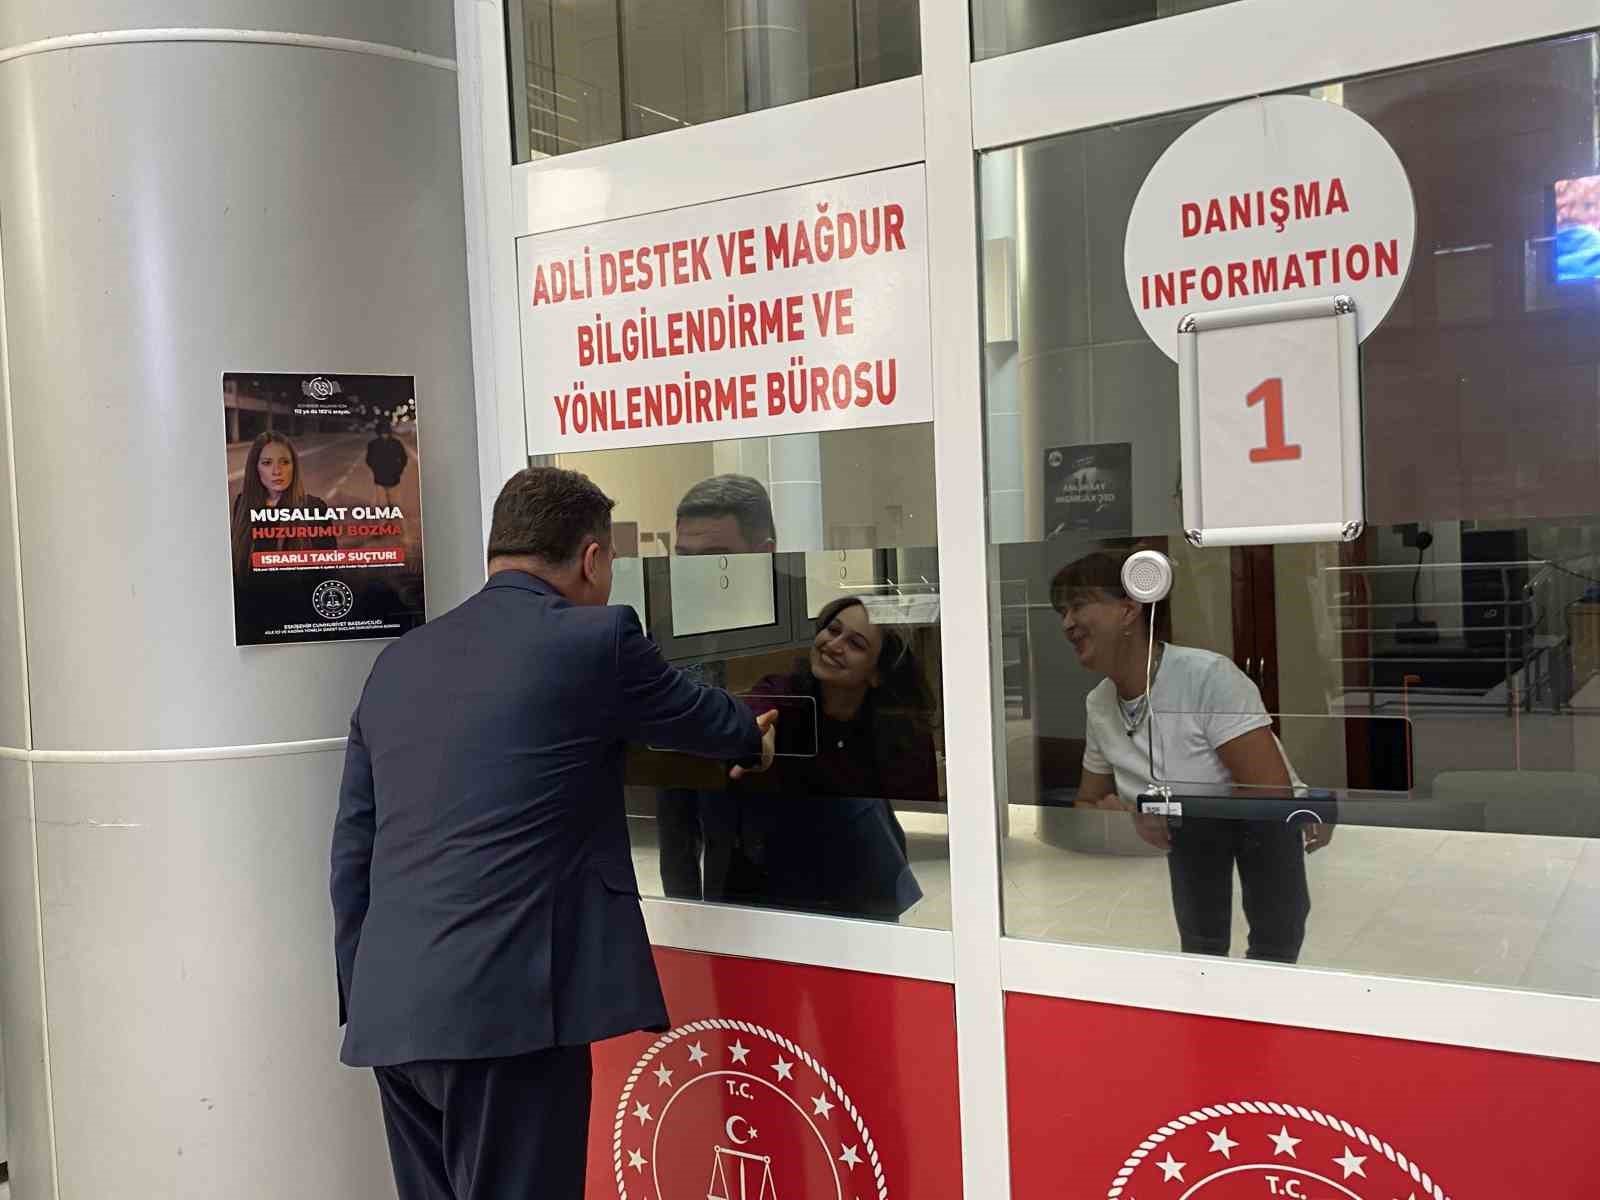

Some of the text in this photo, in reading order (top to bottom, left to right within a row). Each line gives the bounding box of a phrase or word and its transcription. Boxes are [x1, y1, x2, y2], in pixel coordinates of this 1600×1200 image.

[1181, 178, 1349, 238] DANIŞMA
[532, 202, 906, 306] ADLİ DESTEK VE MAĞDUR
[1141, 240, 1399, 309] INFORMATION
[577, 288, 854, 367] BİLGİLENDİRME VE
[554, 356, 897, 435] YÖNLENDİRME BÜROSU
[1246, 377, 1302, 463] 1
[251, 506, 403, 522] MUSALLAT OLMA
[252, 524, 401, 539] HUZURUMU BOZMA
[261, 550, 396, 564] ISRARLI TAKİP SUÇTUR!
[726, 1080, 754, 1099] T.C.
[1265, 1175, 1307, 1200] T.C.
